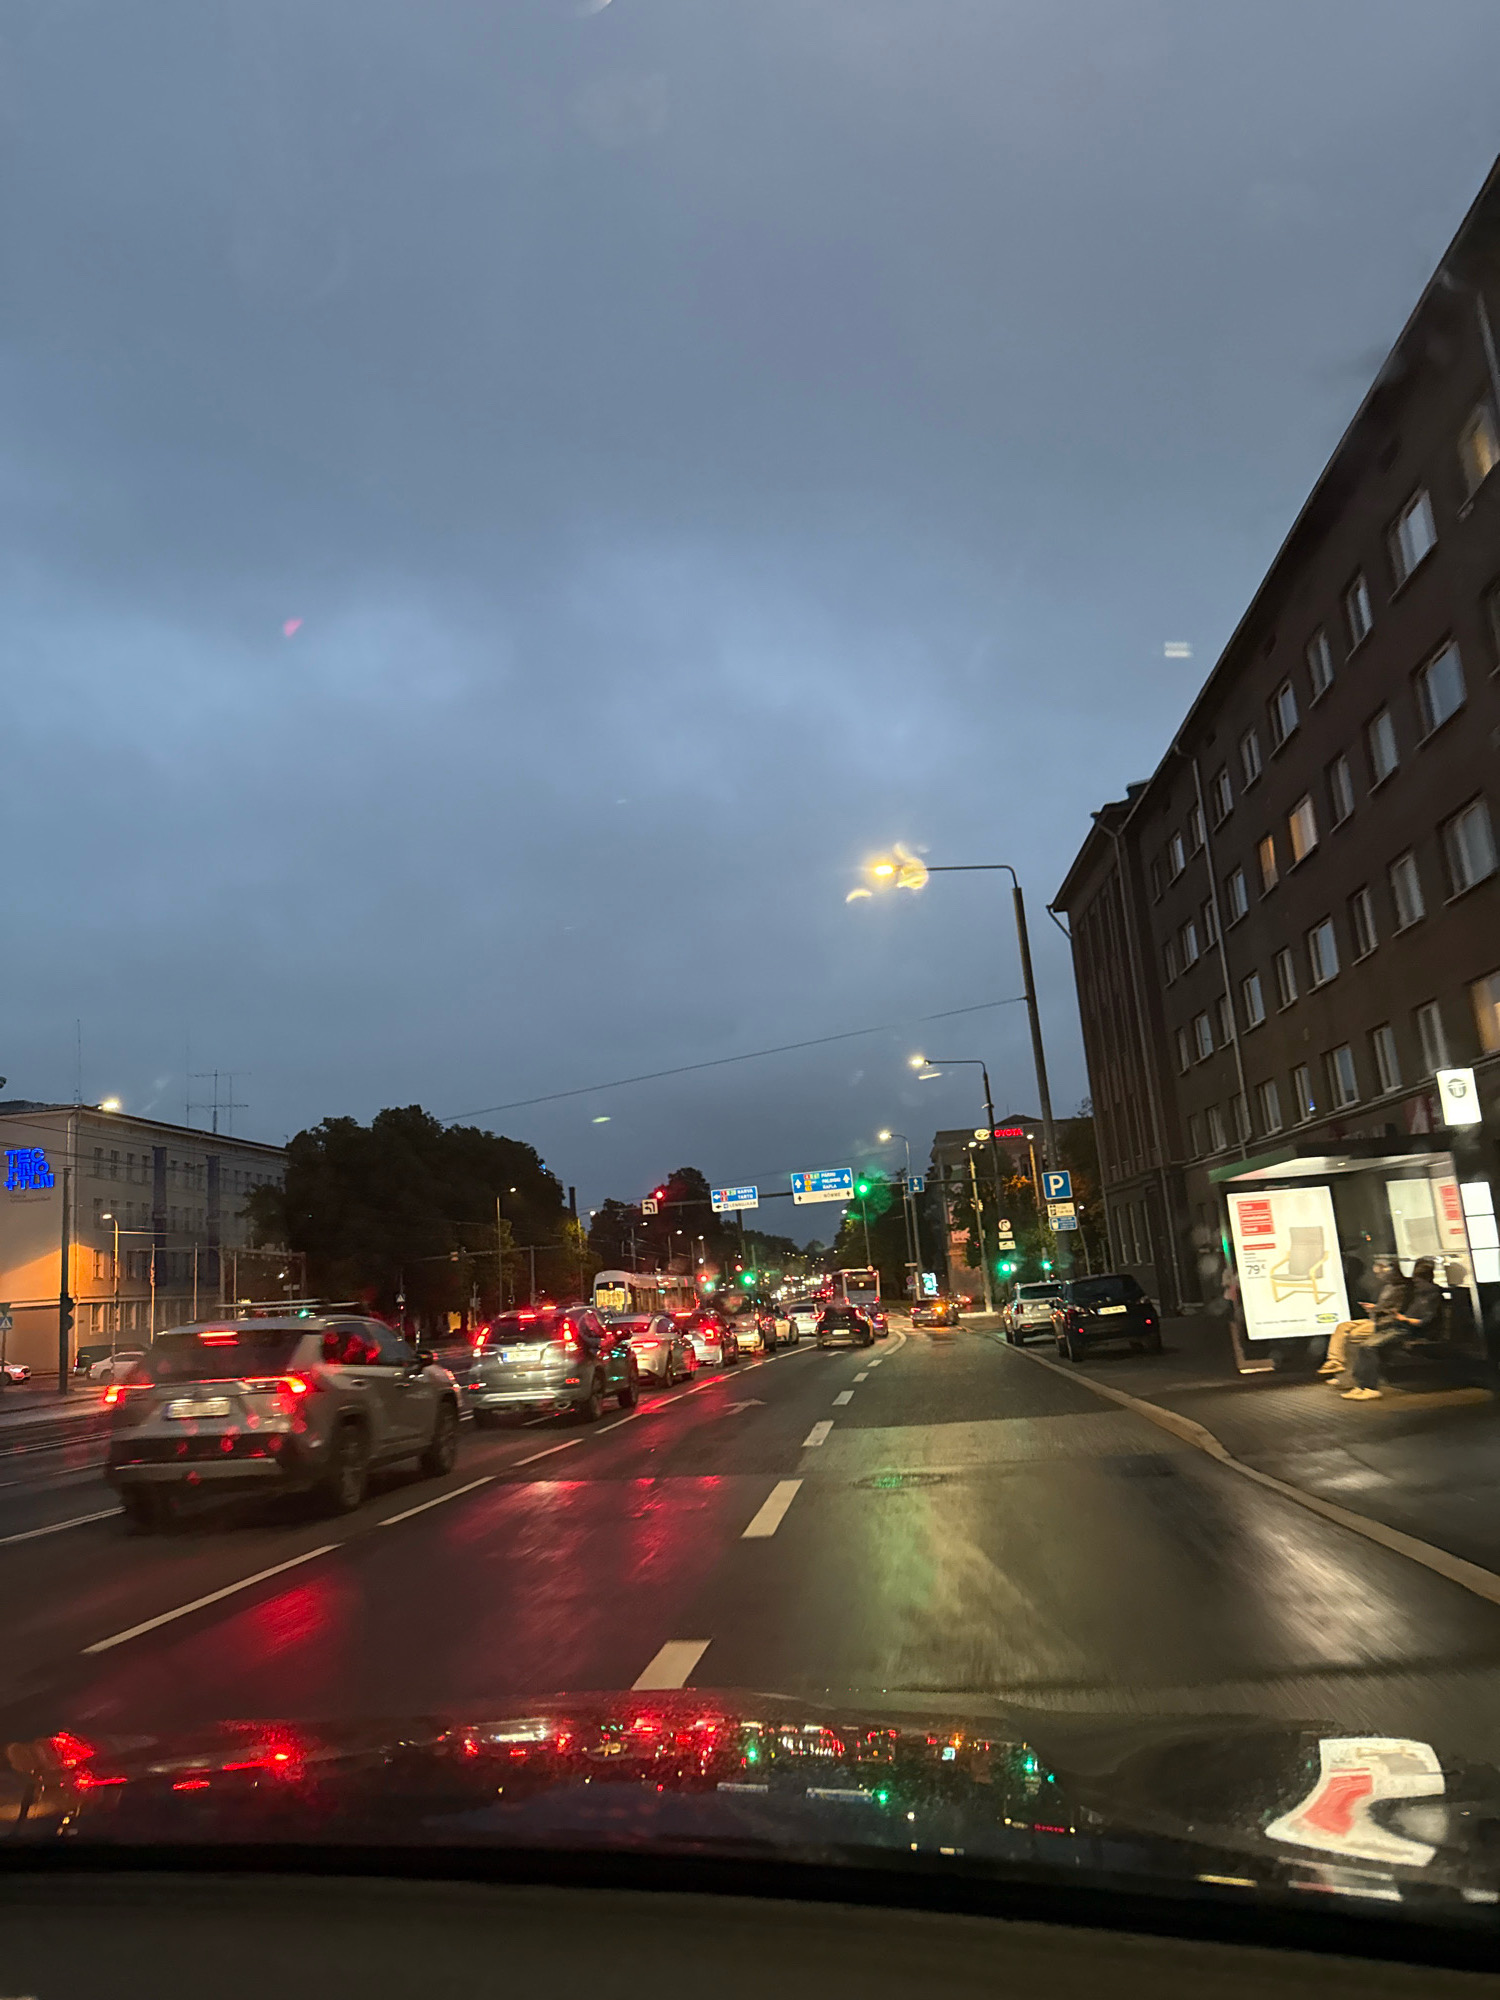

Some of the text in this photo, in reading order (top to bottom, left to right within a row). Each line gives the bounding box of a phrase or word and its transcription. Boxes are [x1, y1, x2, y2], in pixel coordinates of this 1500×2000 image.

[988, 1128, 1024, 1138] OYOTA
[4, 1148, 45, 1162] TEC
[8, 1160, 50, 1177] HNO
[1049, 1175, 1064, 1196] P
[1245, 1264, 1260, 1275] 79
